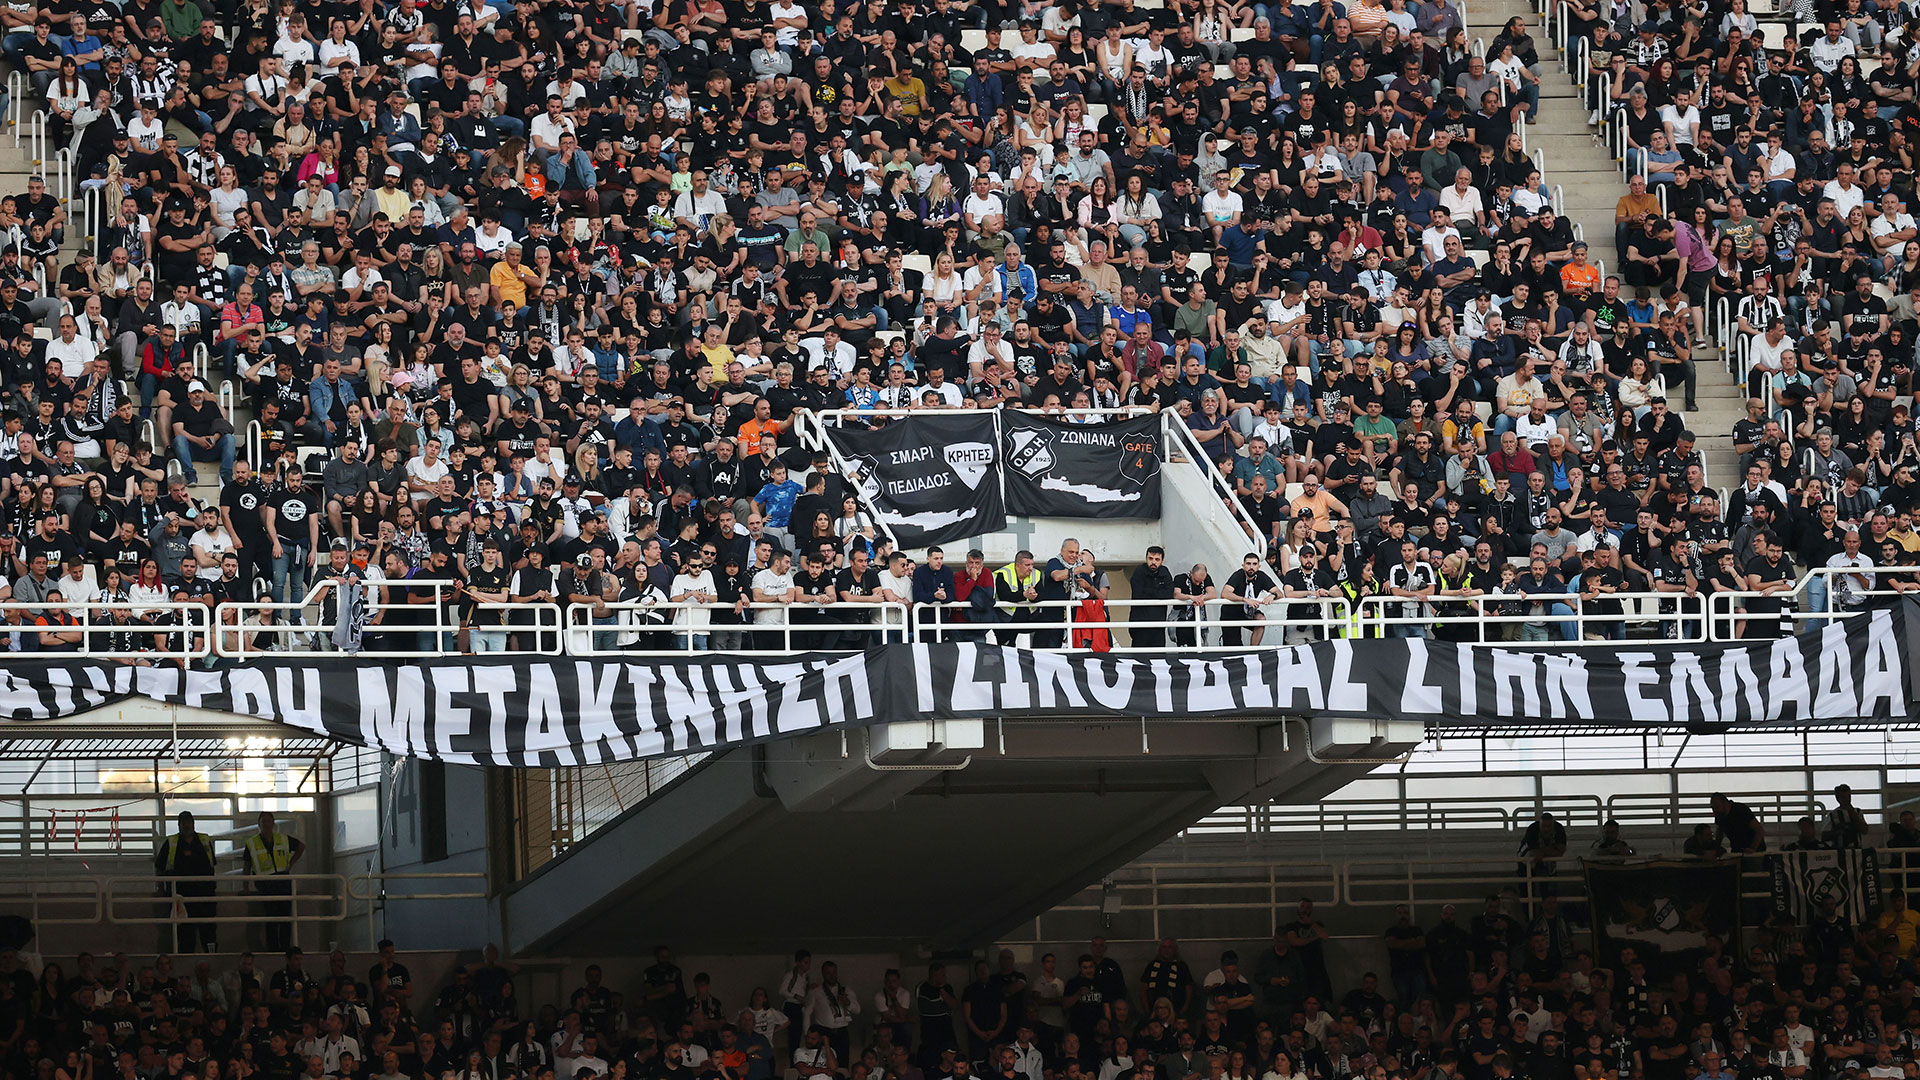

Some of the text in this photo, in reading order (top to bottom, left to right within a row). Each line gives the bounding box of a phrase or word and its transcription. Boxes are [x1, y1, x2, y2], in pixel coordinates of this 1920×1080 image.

[1569, 279, 1592, 287] betsson
[1060, 431, 1116, 447] ΖΩΝΙΑΝΑ
[889, 445, 935, 465] ΣΜΑΡΙ
[948, 448, 991, 463] ΚΡΗΤΕΣ
[1125, 442, 1153, 453] GATE
[1135, 457, 1144, 469] 4
[887, 472, 952, 495] ΠΕΔΙΑΔΟΣ
[1614, 609, 1908, 722] ΕΛΛΑΔΑ
[1866, 871, 1878, 906] CRETE
